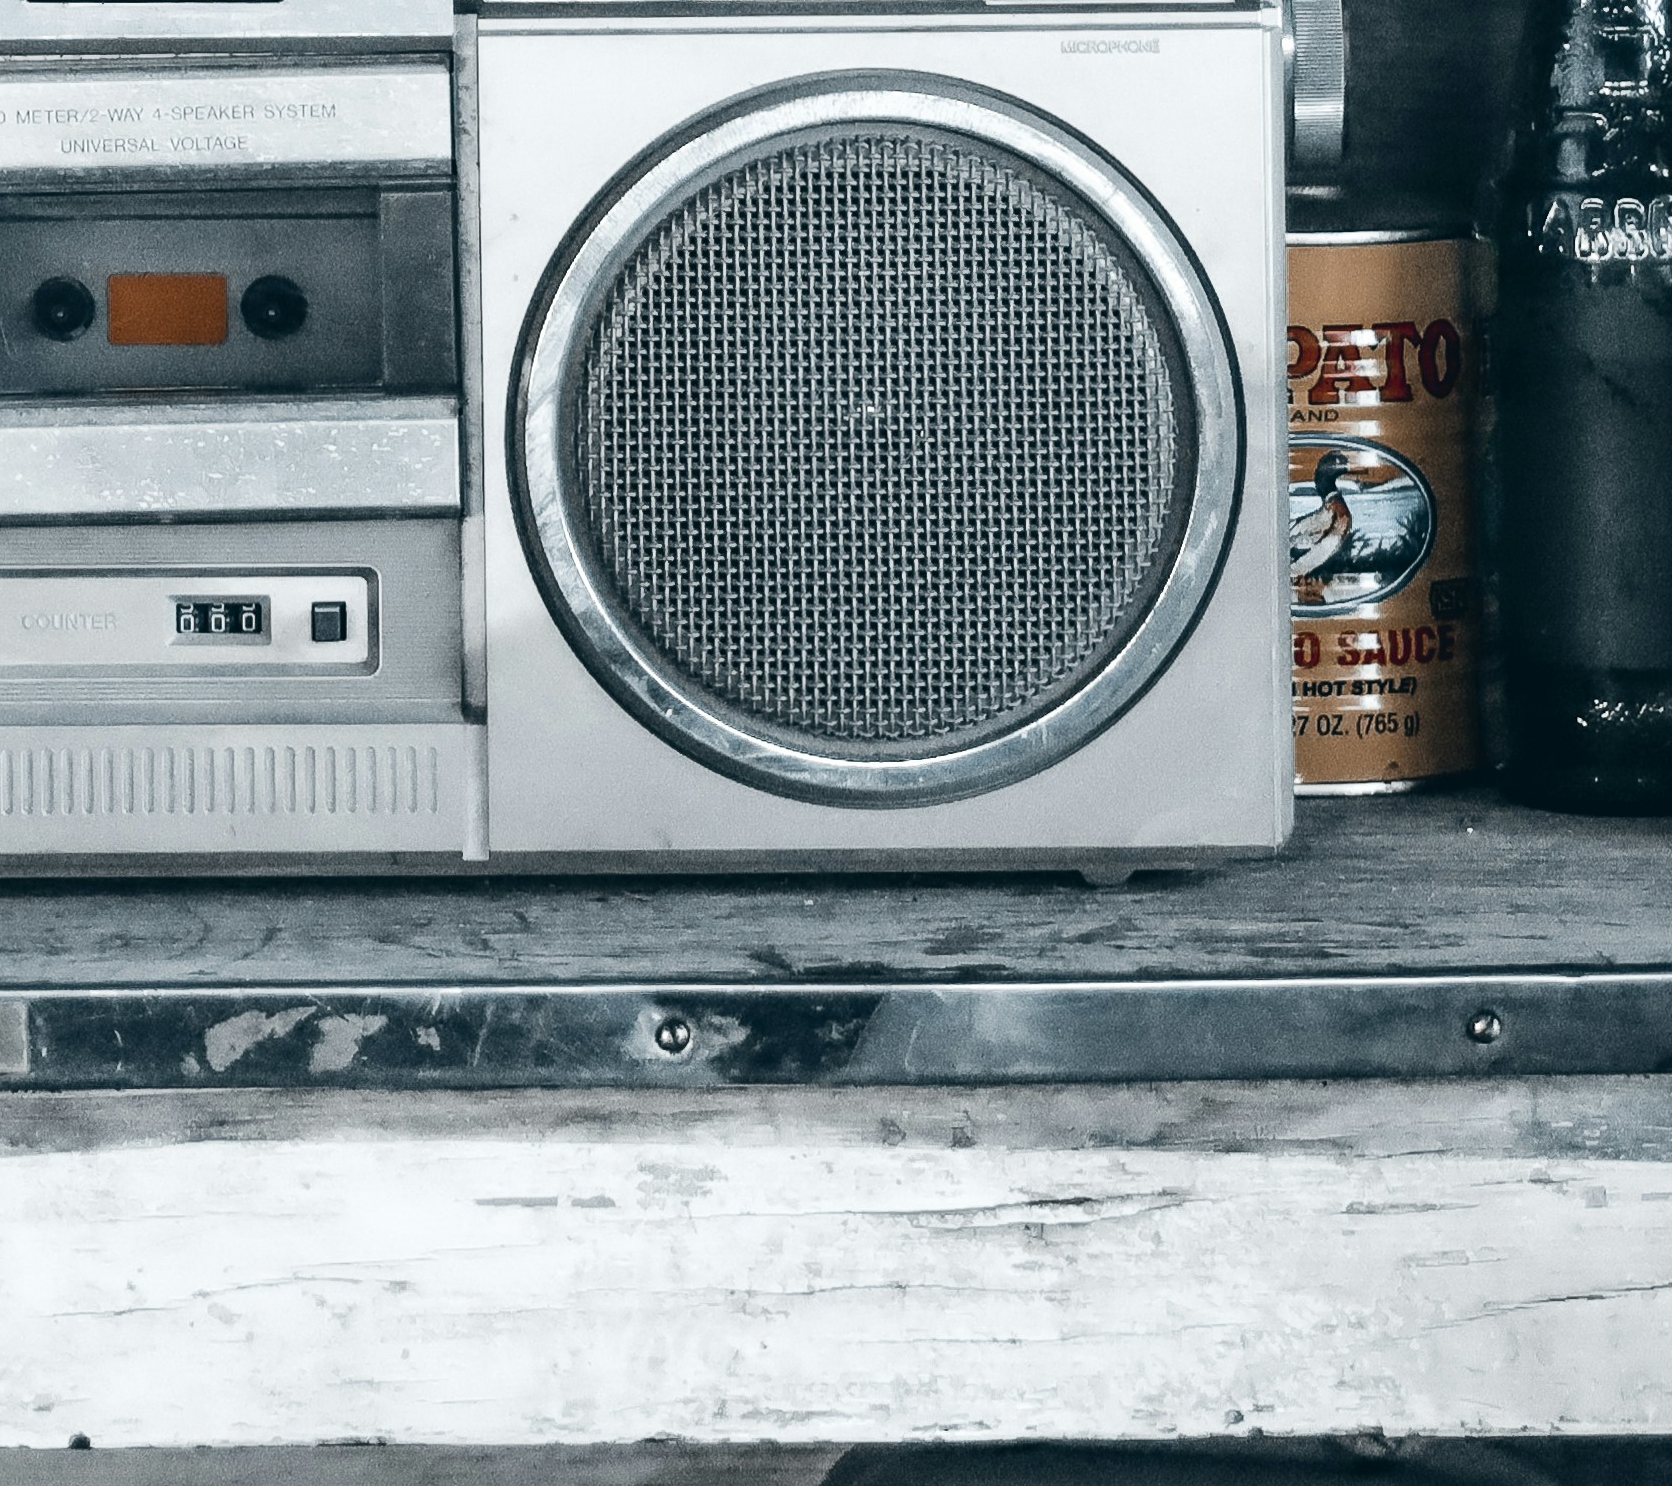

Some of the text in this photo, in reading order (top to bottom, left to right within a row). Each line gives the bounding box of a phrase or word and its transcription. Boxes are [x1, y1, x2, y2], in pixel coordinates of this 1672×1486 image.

[1059, 39, 1161, 55] MICROPHONE
[15, 106, 145, 127] METER/2-WAY
[152, 104, 257, 124] 4-SPEAKER
[263, 102, 338, 122] SYSTEM
[20, 611, 119, 632] COUNTER
[1337, 626, 1455, 668] SAUCE
